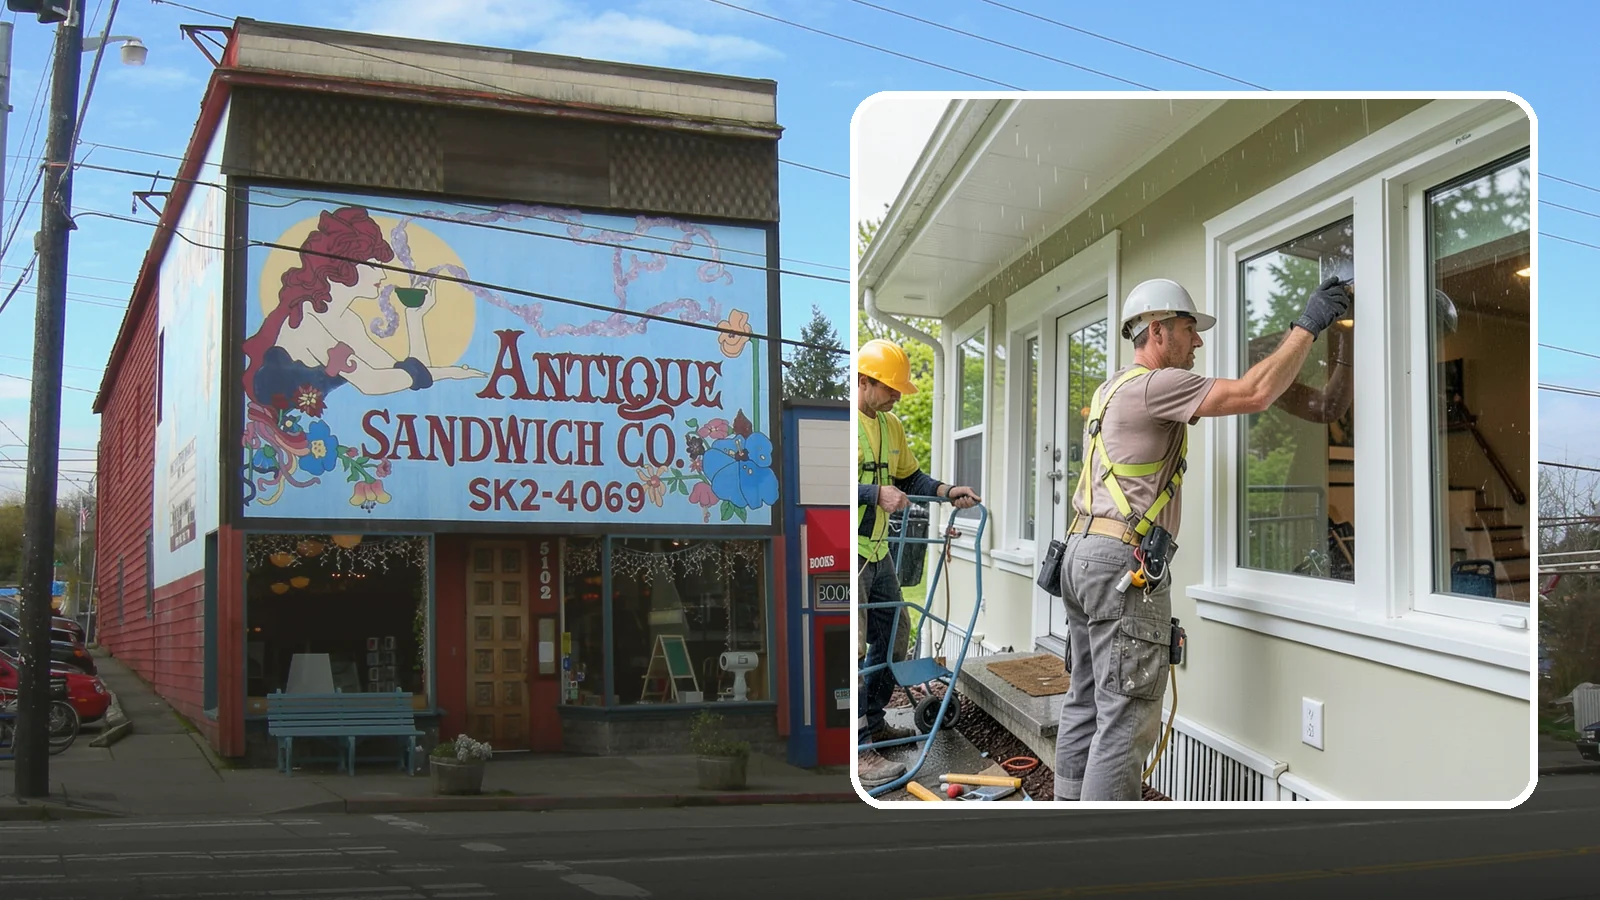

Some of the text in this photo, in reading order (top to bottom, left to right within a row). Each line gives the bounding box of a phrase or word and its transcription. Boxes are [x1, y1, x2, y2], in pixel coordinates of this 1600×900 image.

[475, 328, 724, 421] ANTIQUE
[361, 408, 686, 470] SANDWICH CO.
[467, 476, 647, 514] SK2-4069
[540, 541, 551, 600] 5102
[809, 555, 835, 569] BOOKS
